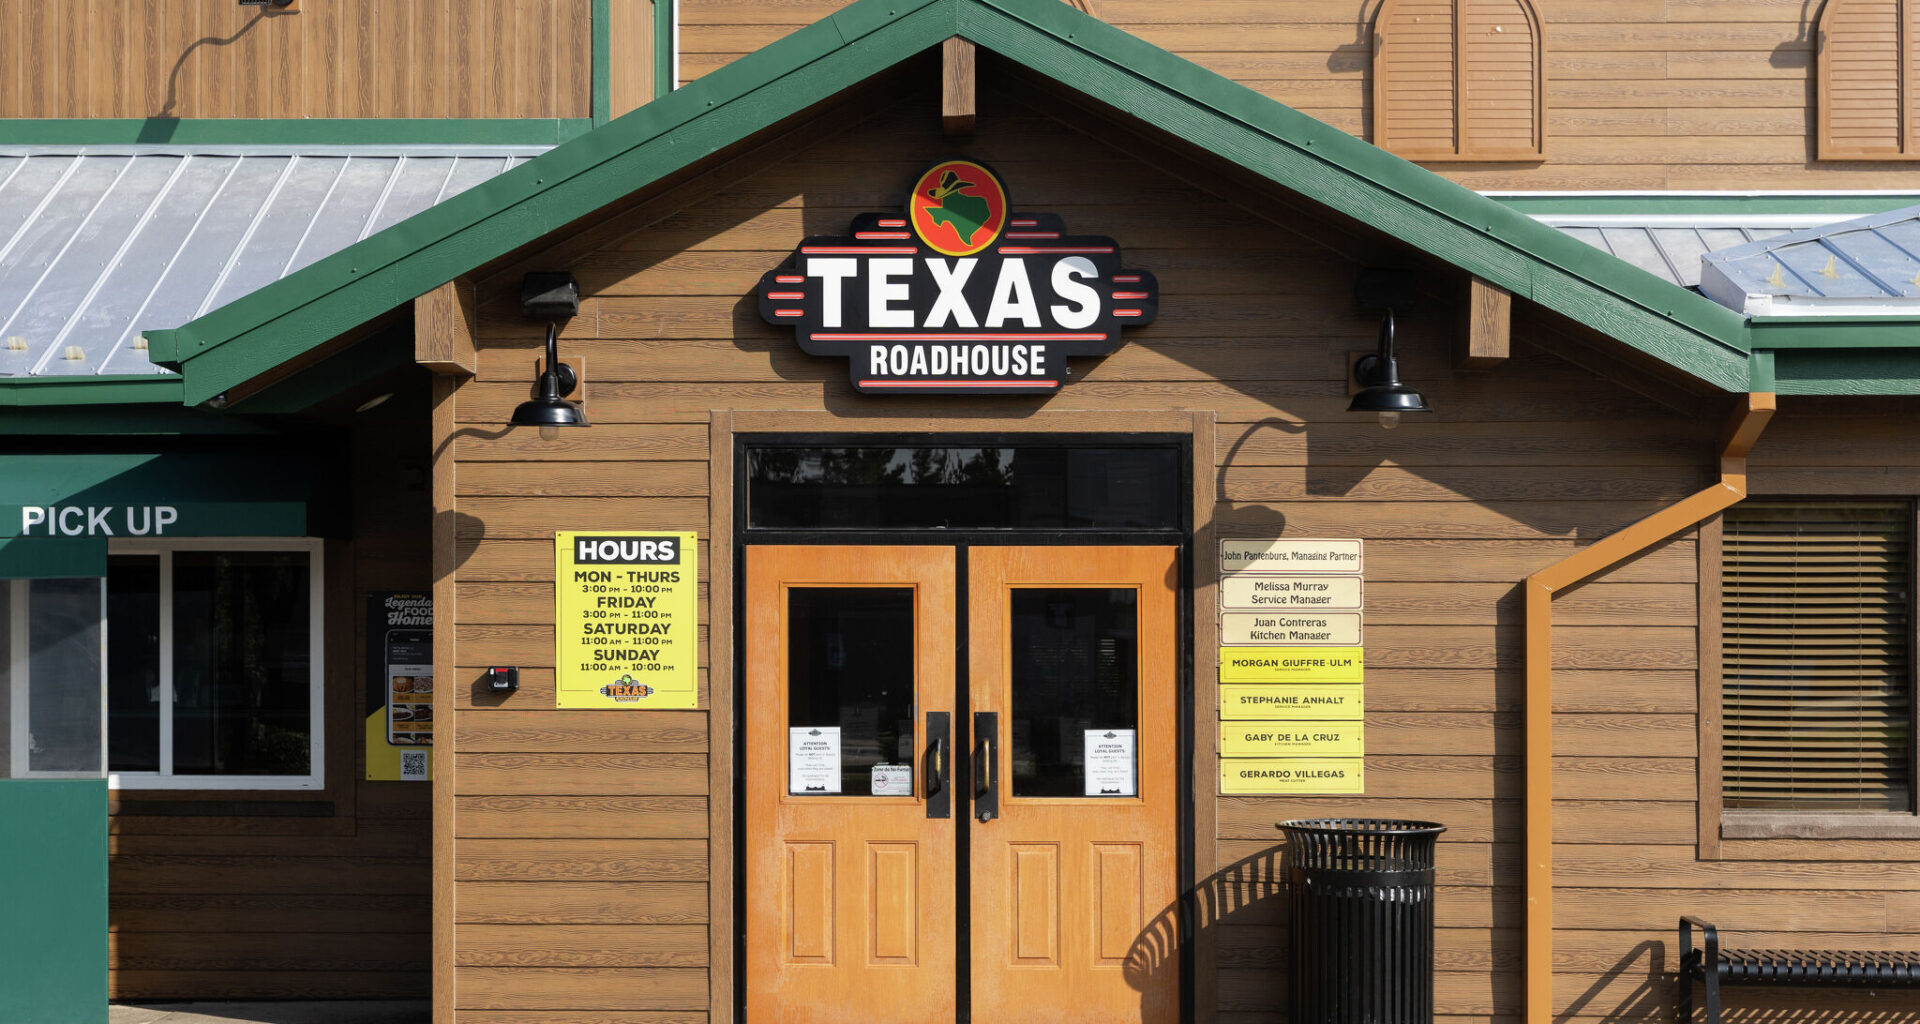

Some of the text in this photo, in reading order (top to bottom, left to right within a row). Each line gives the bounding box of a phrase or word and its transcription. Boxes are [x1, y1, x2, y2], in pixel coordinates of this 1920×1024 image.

[807, 256, 1101, 330] TEXAS
[871, 345, 1045, 376] ROADHOUSE
[22, 506, 178, 536] PICK UP
[579, 541, 675, 560] HOURS
[1224, 550, 1357, 561] John Pantenburg, Managing Partner
[575, 571, 611, 582] MON
[627, 571, 680, 582] THURS
[582, 585, 606, 593] 3:00
[631, 585, 659, 593] 10:00
[1255, 582, 1328, 591] Melissa Murray
[385, 596, 433, 610] Legenda
[598, 597, 656, 608] FRIDAY
[1252, 595, 1331, 604] Service Manager
[583, 610, 606, 618] 3:00
[632, 610, 658, 618] 11:00
[1254, 618, 1326, 627] Juan Contreras
[584, 623, 671, 634] SATURDAY
[1251, 631, 1330, 639] Kitchen Manager
[633, 637, 658, 645] 11:00
[594, 650, 659, 660] SUNDAY
[581, 663, 607, 671] 11:00
[632, 663, 660, 671] 10:00
[608, 685, 647, 696] TEXAS
